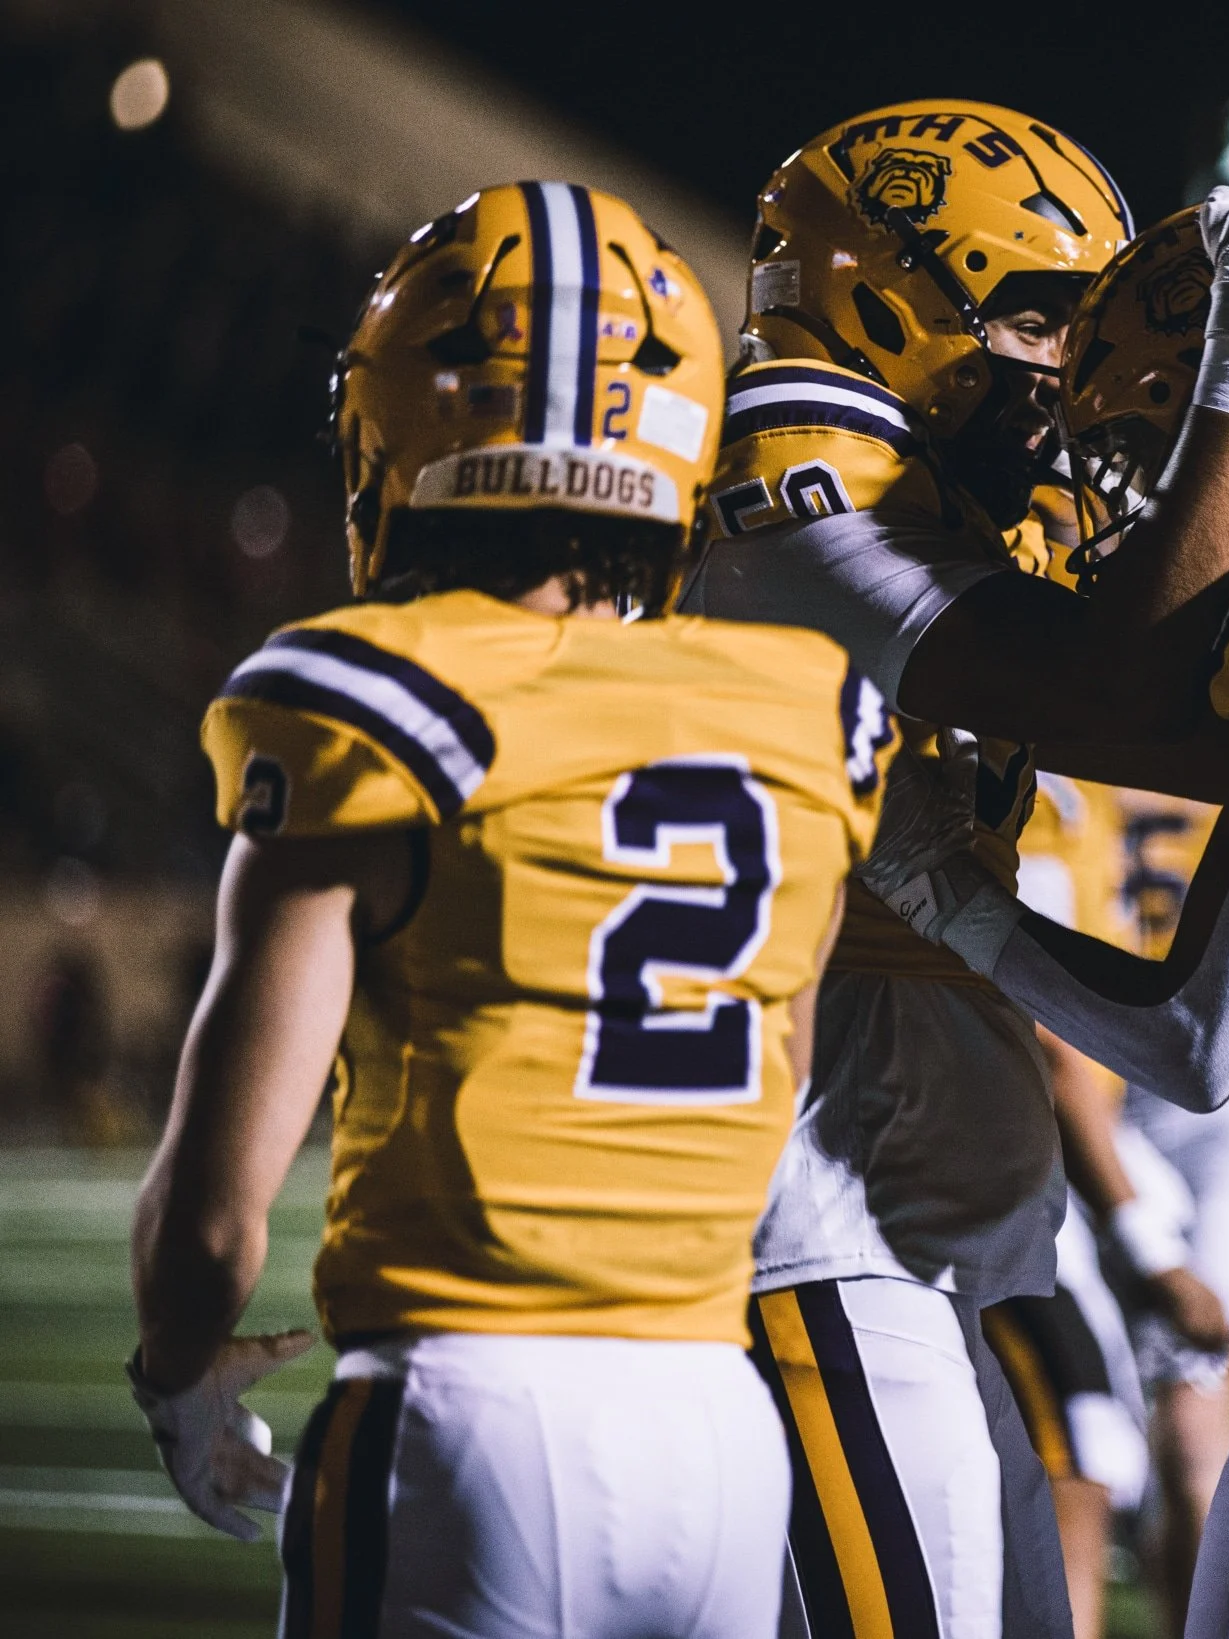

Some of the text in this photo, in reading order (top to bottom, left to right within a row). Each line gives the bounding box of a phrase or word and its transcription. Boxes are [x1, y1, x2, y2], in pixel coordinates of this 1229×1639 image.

[843, 113, 1025, 169] MHS
[602, 381, 632, 440] 2
[454, 455, 656, 508] BULLDOGS
[573, 753, 784, 1107] 2
